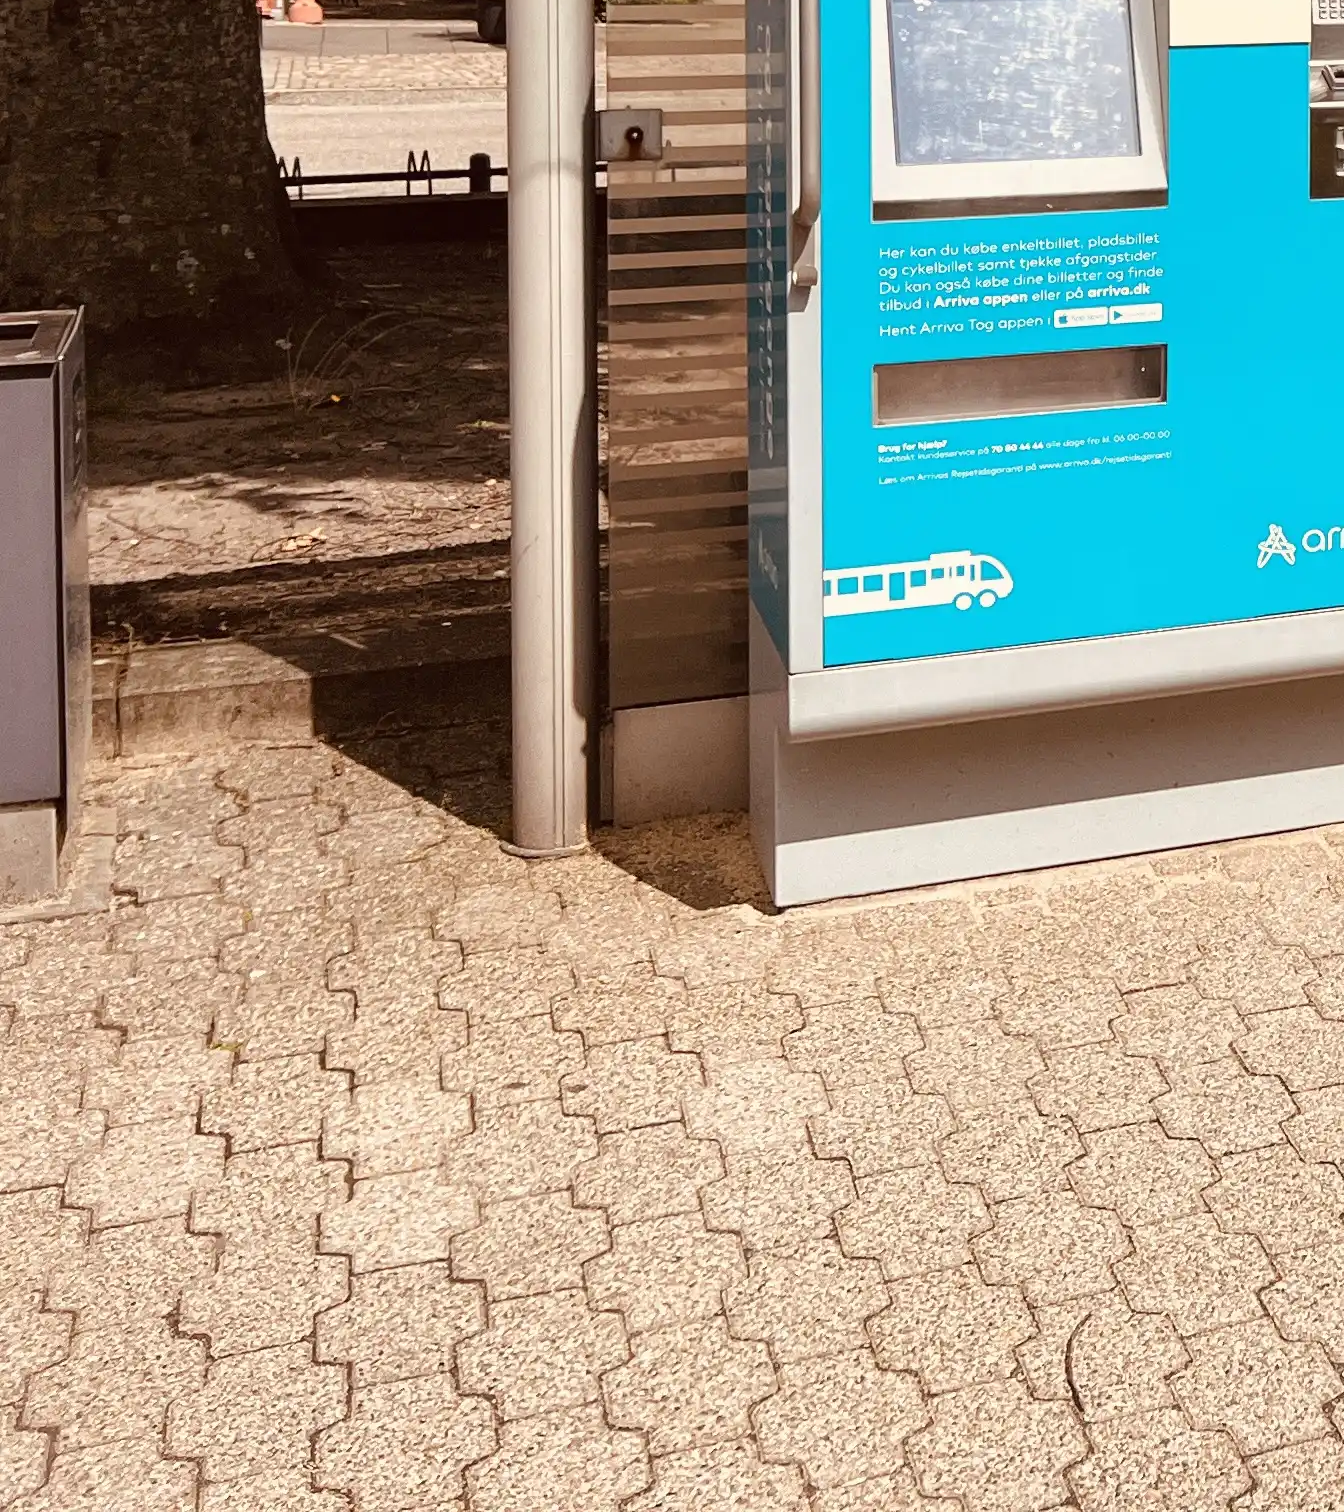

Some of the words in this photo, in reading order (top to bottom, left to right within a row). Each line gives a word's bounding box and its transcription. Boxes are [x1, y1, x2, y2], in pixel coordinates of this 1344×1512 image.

[880, 249, 904, 258] Her
[910, 248, 936, 257] kan
[941, 244, 958, 255] du
[964, 242, 997, 254] købe
[1088, 233, 1159, 249] pladsbillet
[879, 268, 897, 278] og
[902, 262, 972, 276] cykelbillet
[978, 259, 1015, 271] samt
[1020, 256, 1061, 270] tjekke
[880, 282, 899, 294] Du
[906, 283, 930, 292] kan
[936, 278, 970, 293] også
[976, 276, 1009, 287] købe
[1014, 275, 1043, 285] dine
[1048, 272, 1102, 283] billetter
[1107, 271, 1123, 282] og
[1128, 267, 1163, 277] finde
[880, 298, 921, 311] tilbud
[934, 295, 979, 308] Arriva
[983, 294, 1028, 307] appen
[1032, 291, 1060, 301] eller
[1066, 287, 1083, 301] på
[1088, 283, 1150, 297] arriva.dk
[880, 325, 915, 336] Hent
[920, 322, 963, 333] Arriva
[970, 319, 993, 332] Tog
[998, 318, 1043, 329] appen
